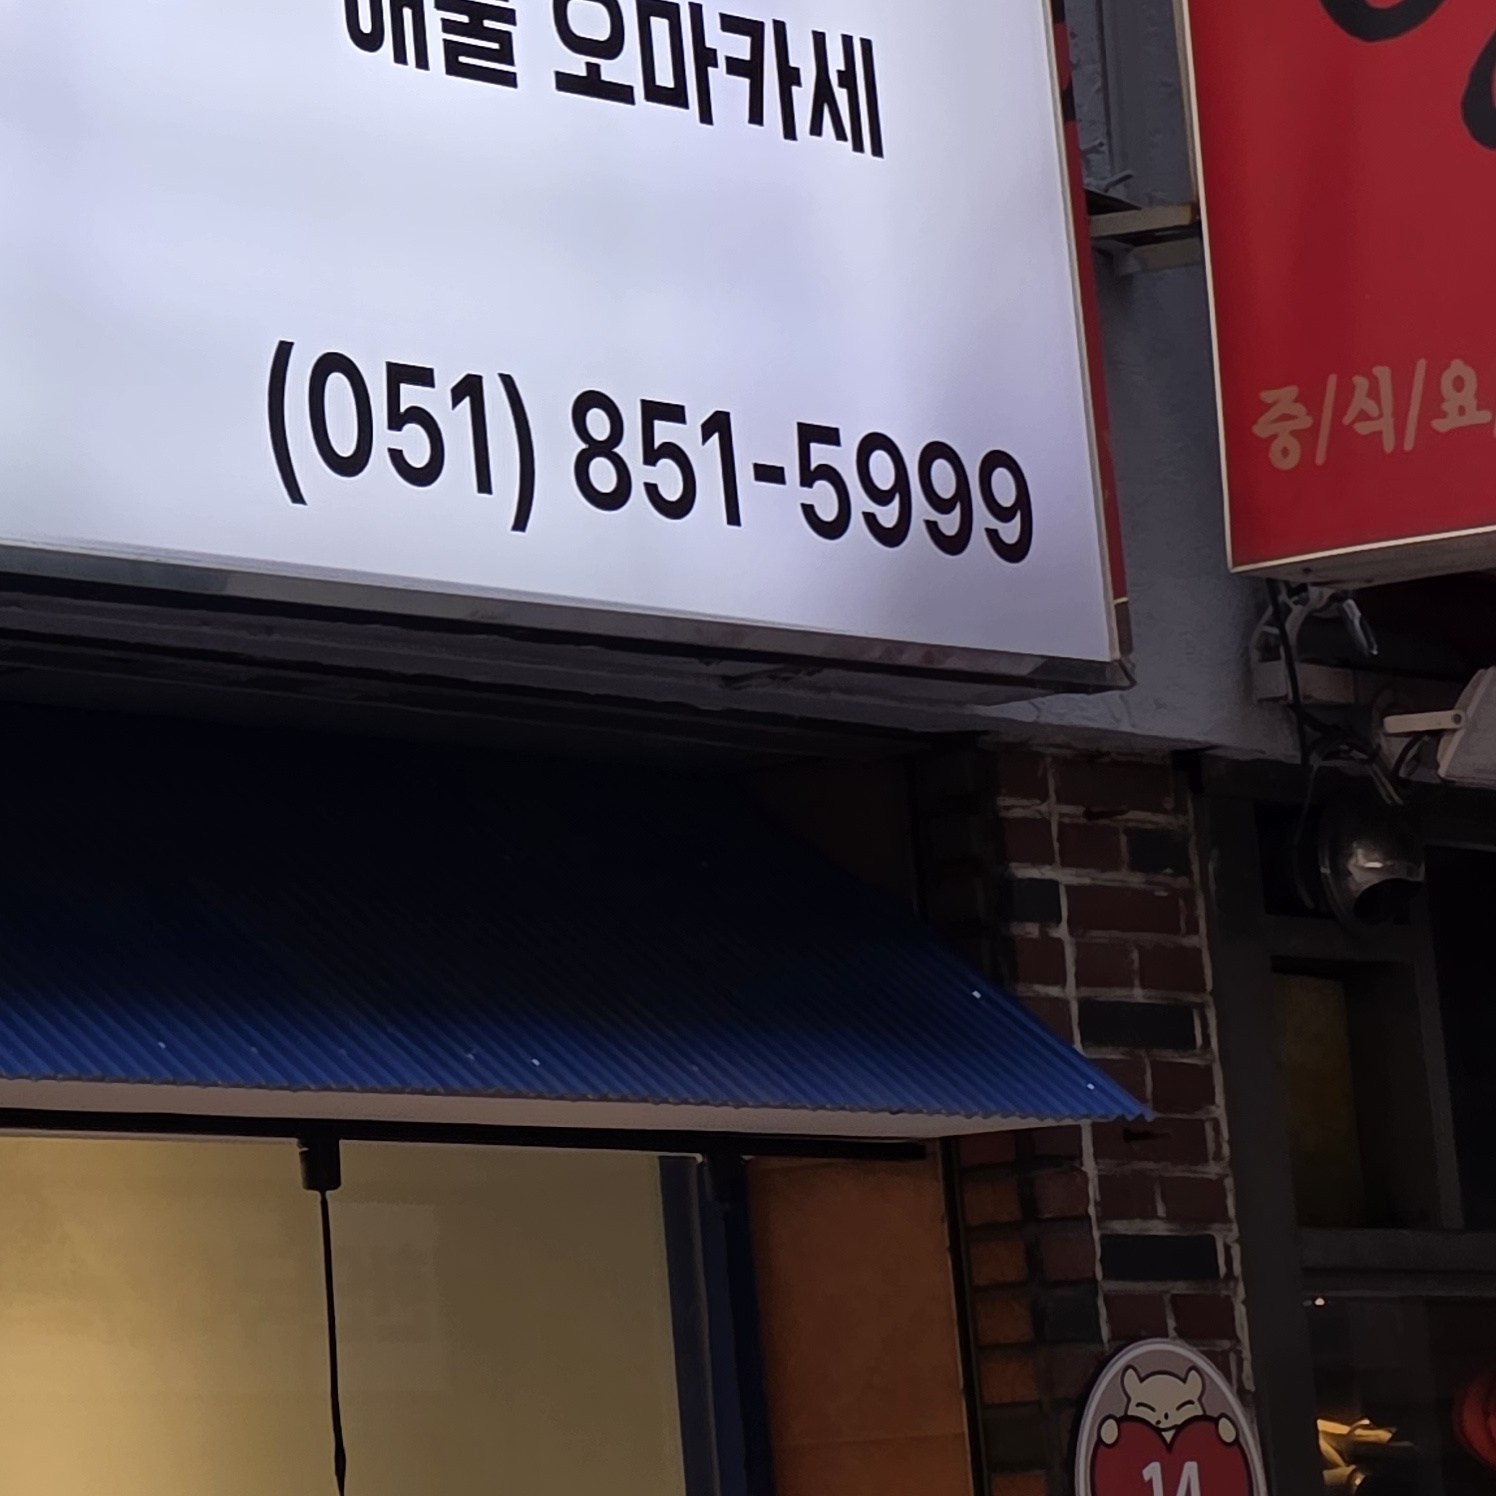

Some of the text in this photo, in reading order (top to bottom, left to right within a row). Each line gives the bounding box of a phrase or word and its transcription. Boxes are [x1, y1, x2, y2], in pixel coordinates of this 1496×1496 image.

[267, 340, 1034, 565] (051) 851-5999
[1252, 358, 1496, 471] 중/식/요
